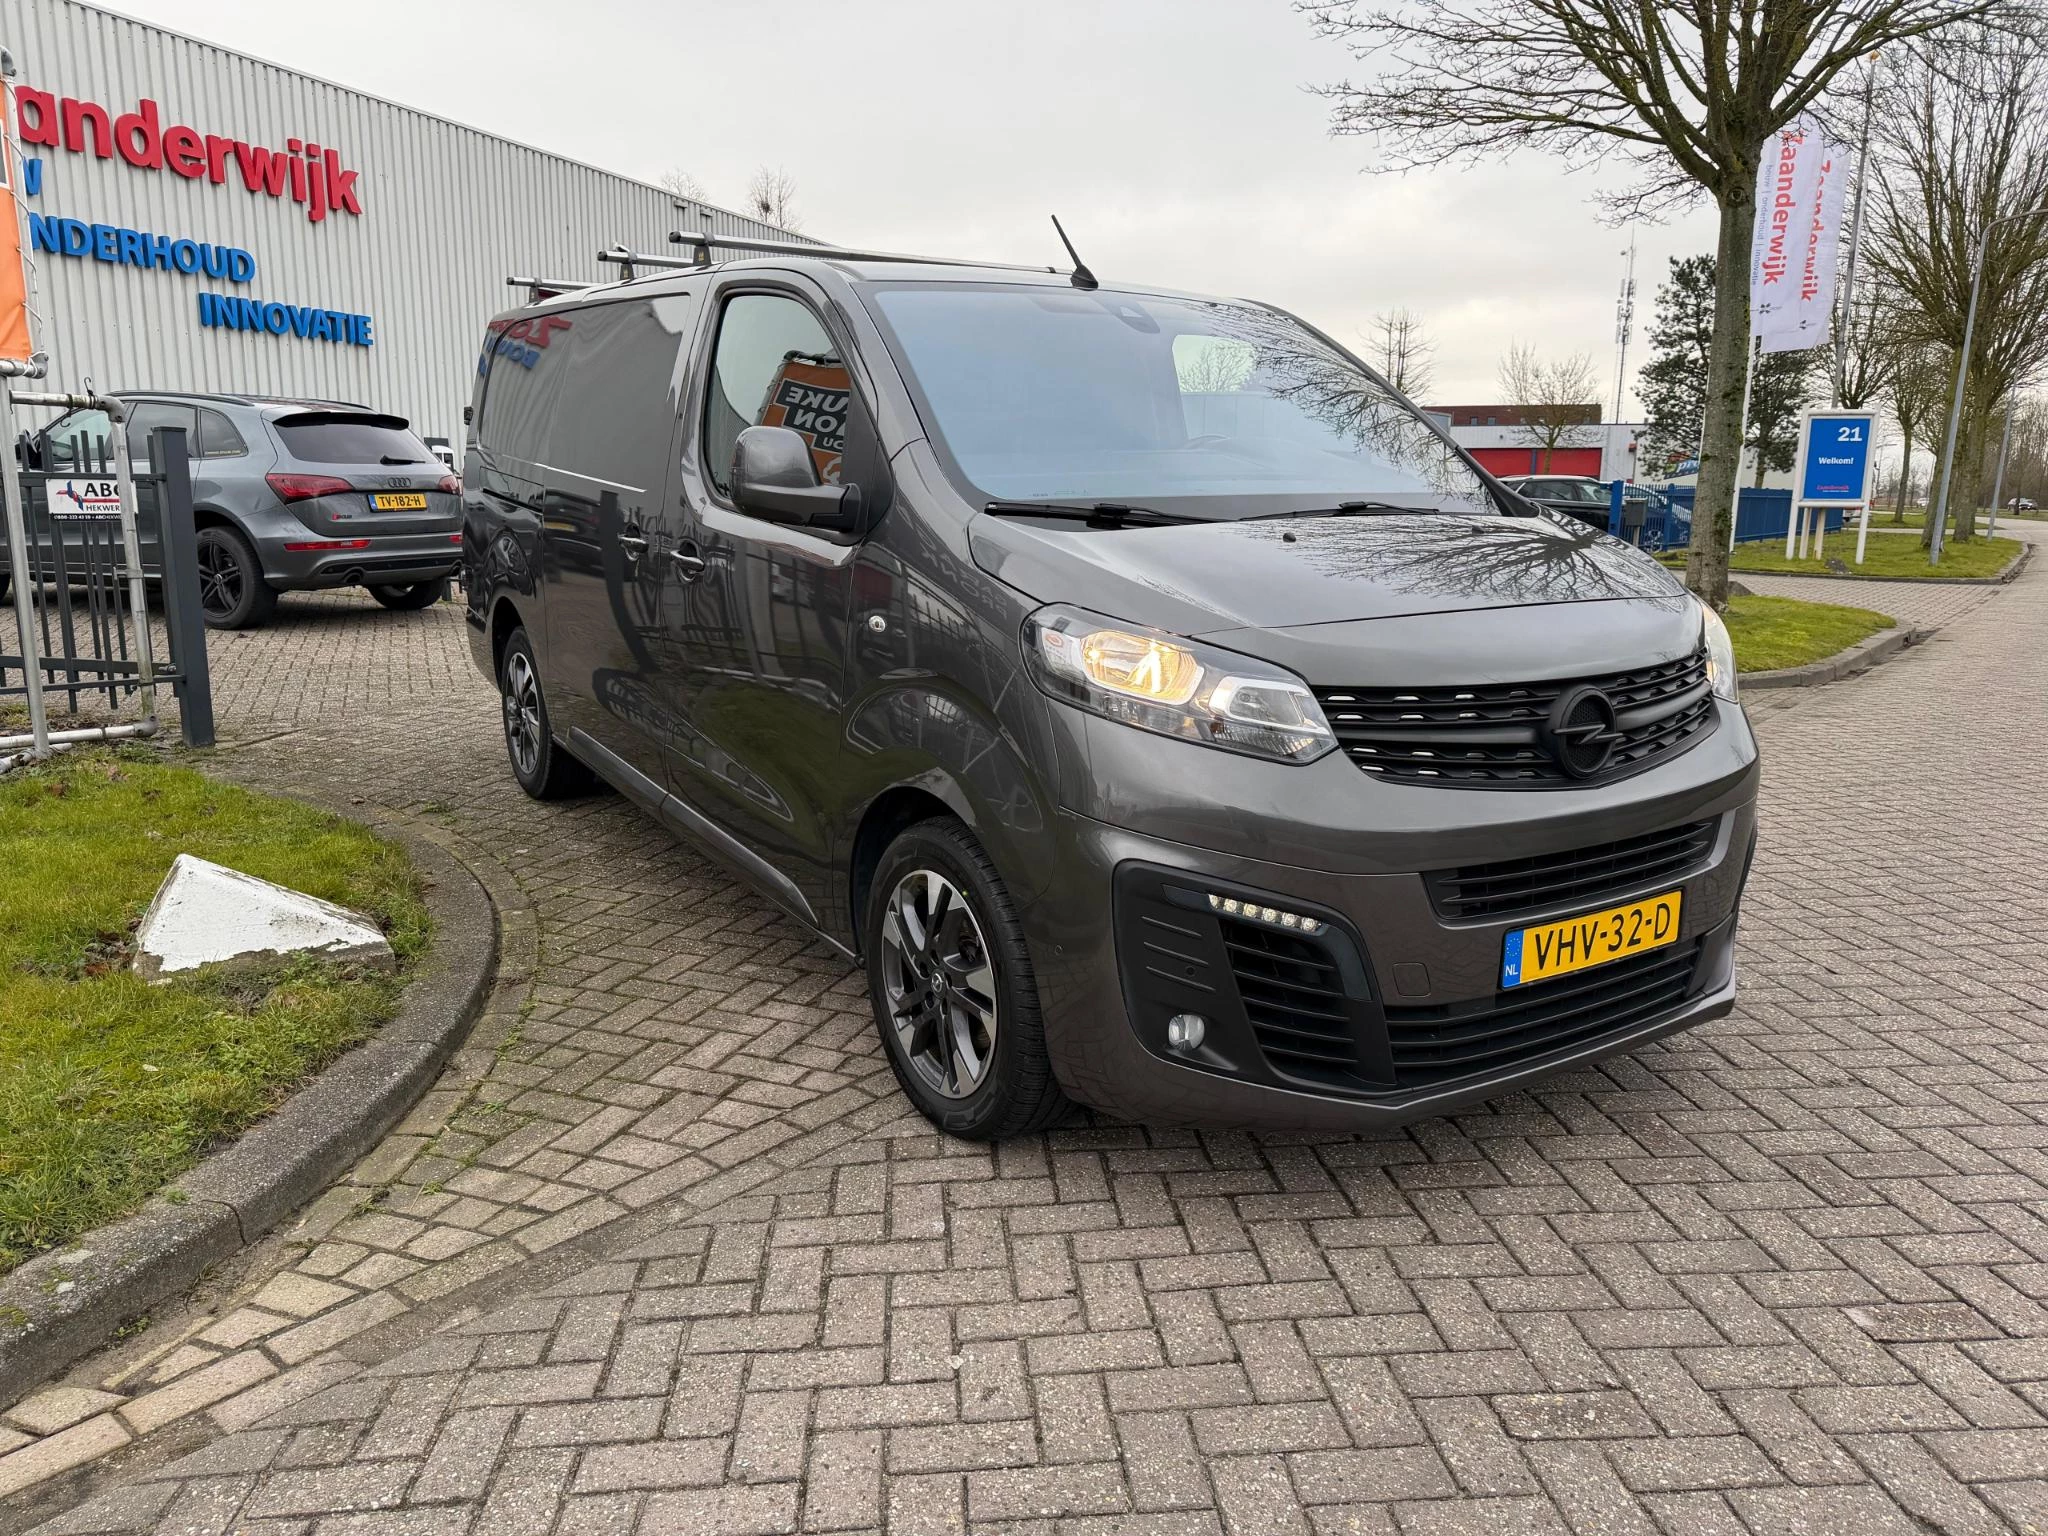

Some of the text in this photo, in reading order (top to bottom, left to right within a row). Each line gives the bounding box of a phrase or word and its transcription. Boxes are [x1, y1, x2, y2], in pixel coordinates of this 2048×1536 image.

[14, 86, 362, 222] anderwijk
[29, 212, 256, 283] NDERHOUD
[200, 292, 374, 346] INNOVATIE
[1837, 426, 1863, 442] 21
[1818, 456, 1854, 465] Welkom!
[86, 504, 121, 512] HEKWER
[379, 496, 422, 508] TV-182-H
[1534, 902, 1671, 971] VHV-32-D
[1505, 963, 1519, 977] NL
